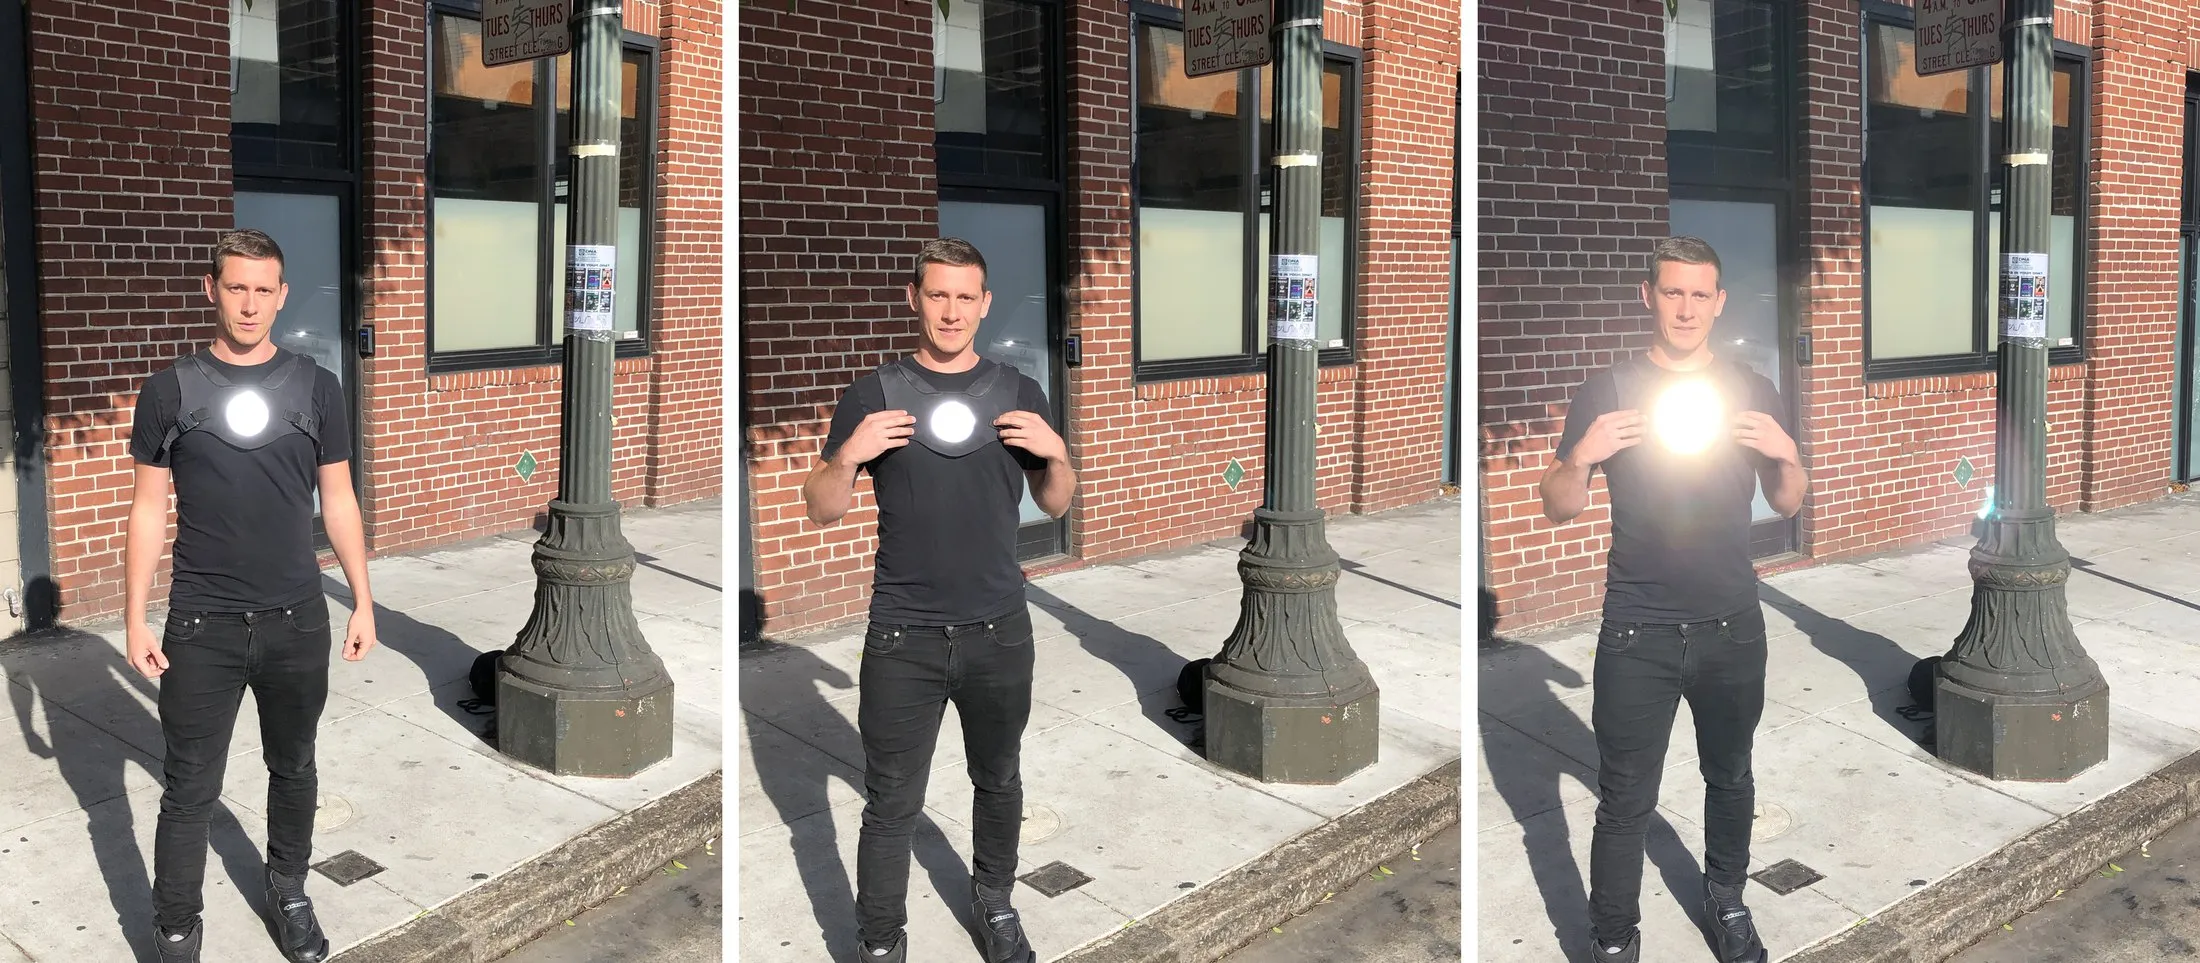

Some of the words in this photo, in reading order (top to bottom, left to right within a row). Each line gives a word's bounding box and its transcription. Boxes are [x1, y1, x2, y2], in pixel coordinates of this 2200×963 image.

[486, 14, 510, 38] TUES
[529, 3, 563, 28] THURS
[1187, 25, 1212, 49] TUES
[1231, 14, 1265, 39] THURS
[1918, 24, 1943, 47] TUES
[1962, 12, 1995, 38] THURS
[489, 44, 518, 61] STREET
[522, 36, 563, 55] CLEG
[1192, 55, 1220, 72] STREET
[1224, 47, 1264, 66] CLEG
[1922, 53, 1951, 70] STREET
[1955, 46, 1995, 64] CLEG
